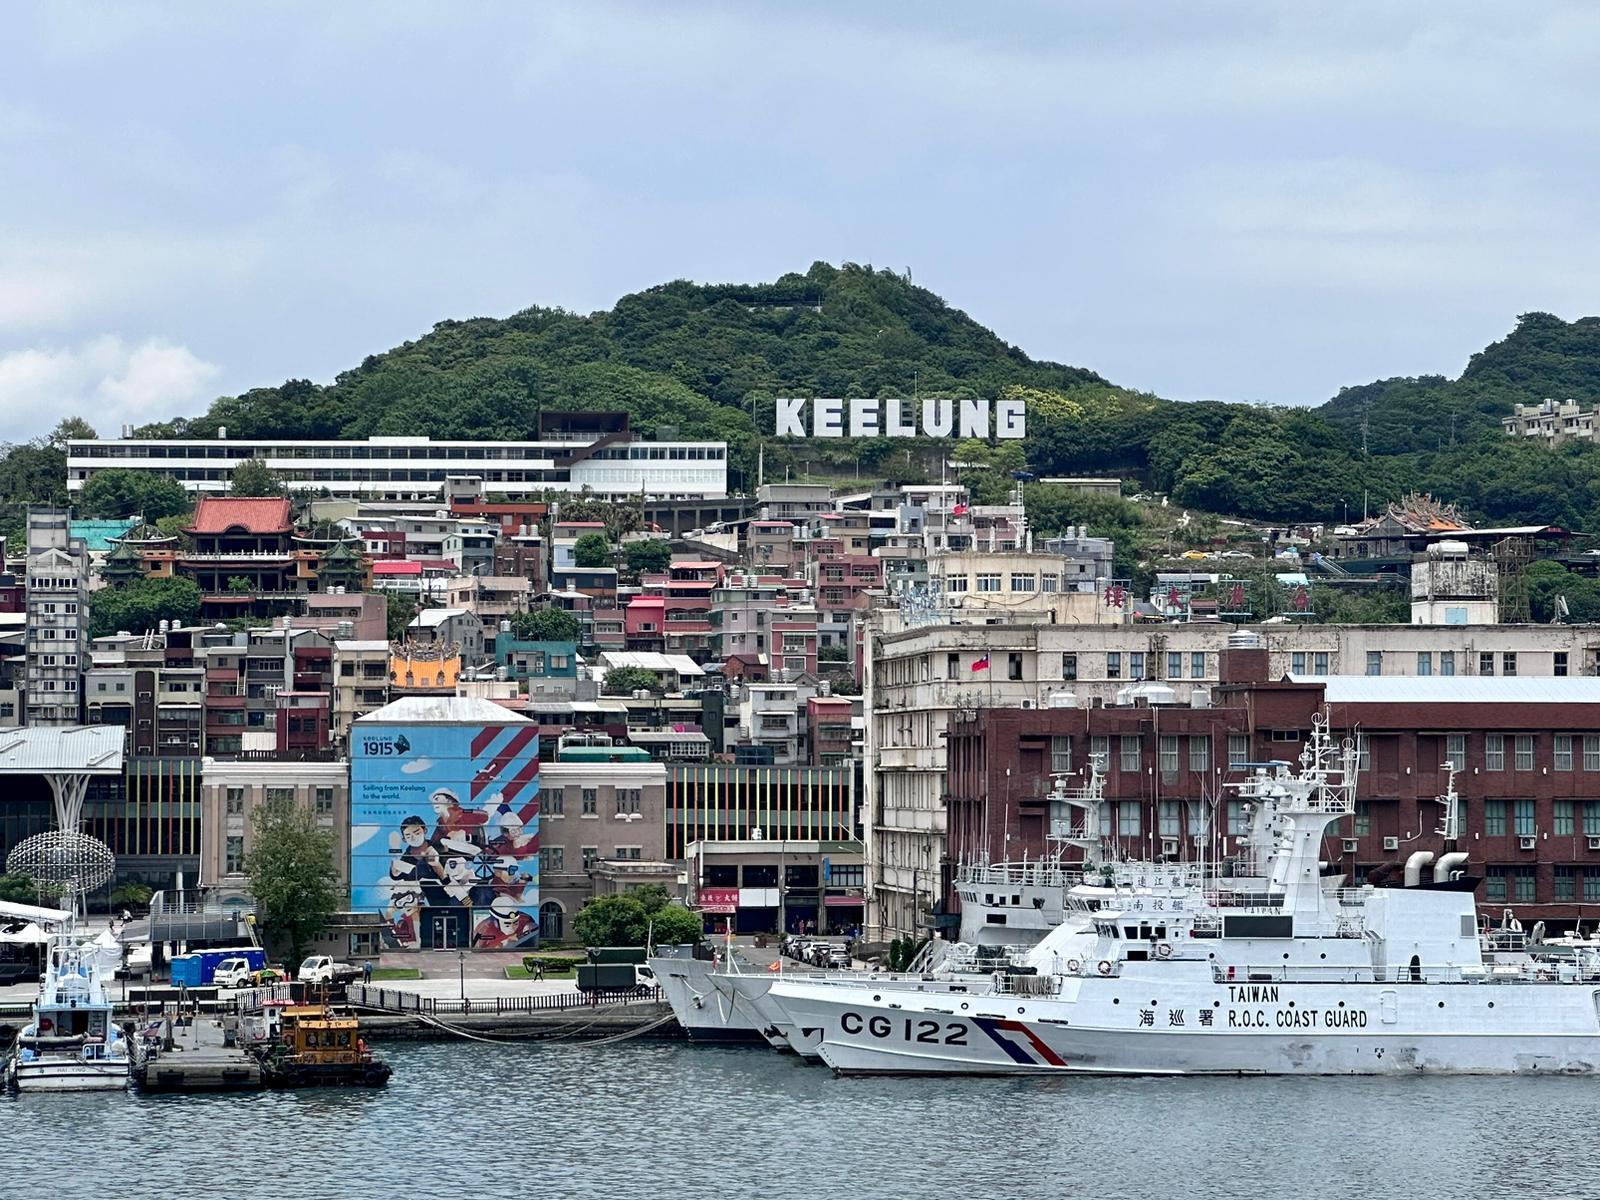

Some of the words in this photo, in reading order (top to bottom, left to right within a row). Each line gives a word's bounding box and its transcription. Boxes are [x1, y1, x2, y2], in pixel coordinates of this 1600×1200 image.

[776, 398, 1026, 438] KEELUNG
[363, 742, 393, 756] 1915
[363, 785, 384, 793] Sailing
[400, 785, 426, 793] Keelung
[1133, 899, 1184, 911] 南投艦
[1228, 986, 1279, 1003] TAIWAN
[1138, 1009, 1214, 1027] 海巡署
[1228, 1010, 1269, 1028] R.O.C.
[1276, 1010, 1319, 1028] COAST
[1325, 1010, 1368, 1028] GUARD
[840, 1012, 892, 1039] CG
[904, 1018, 969, 1046] 122
